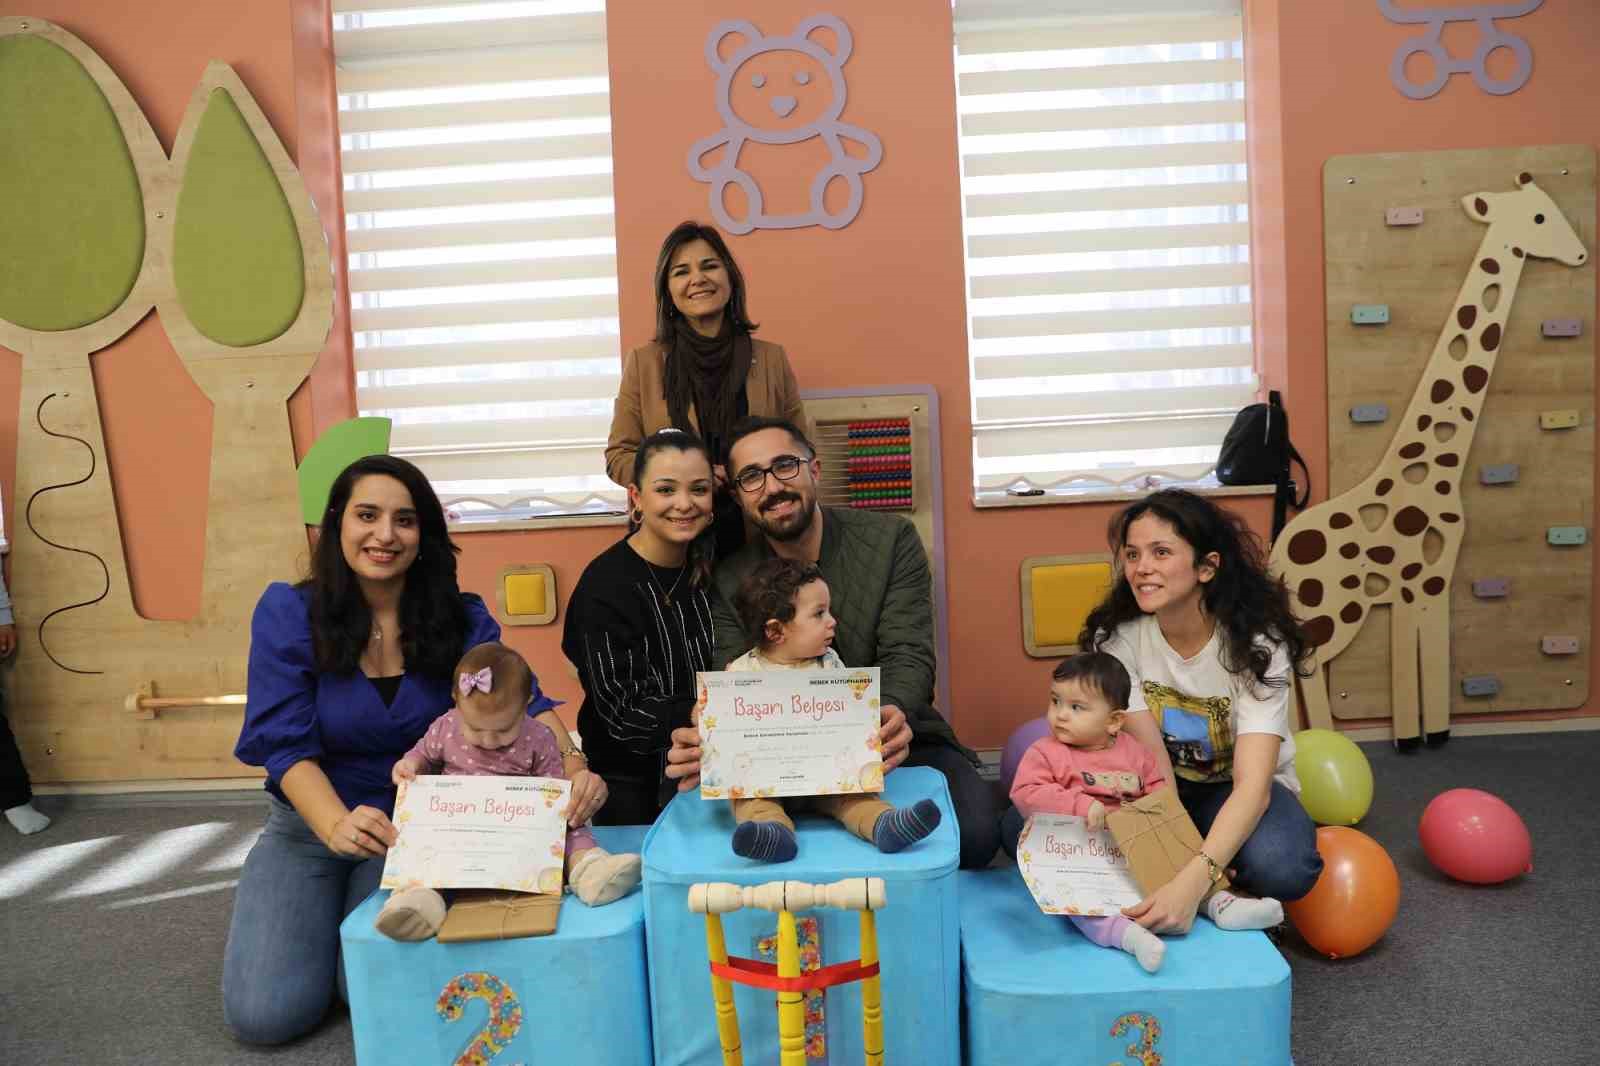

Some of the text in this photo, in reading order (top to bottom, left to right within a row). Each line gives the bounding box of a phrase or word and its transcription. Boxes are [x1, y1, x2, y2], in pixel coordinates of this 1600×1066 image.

[734, 696, 784, 721] Başarı
[1045, 833, 1121, 864] Başarı Belge
[435, 972, 522, 1066] 2
